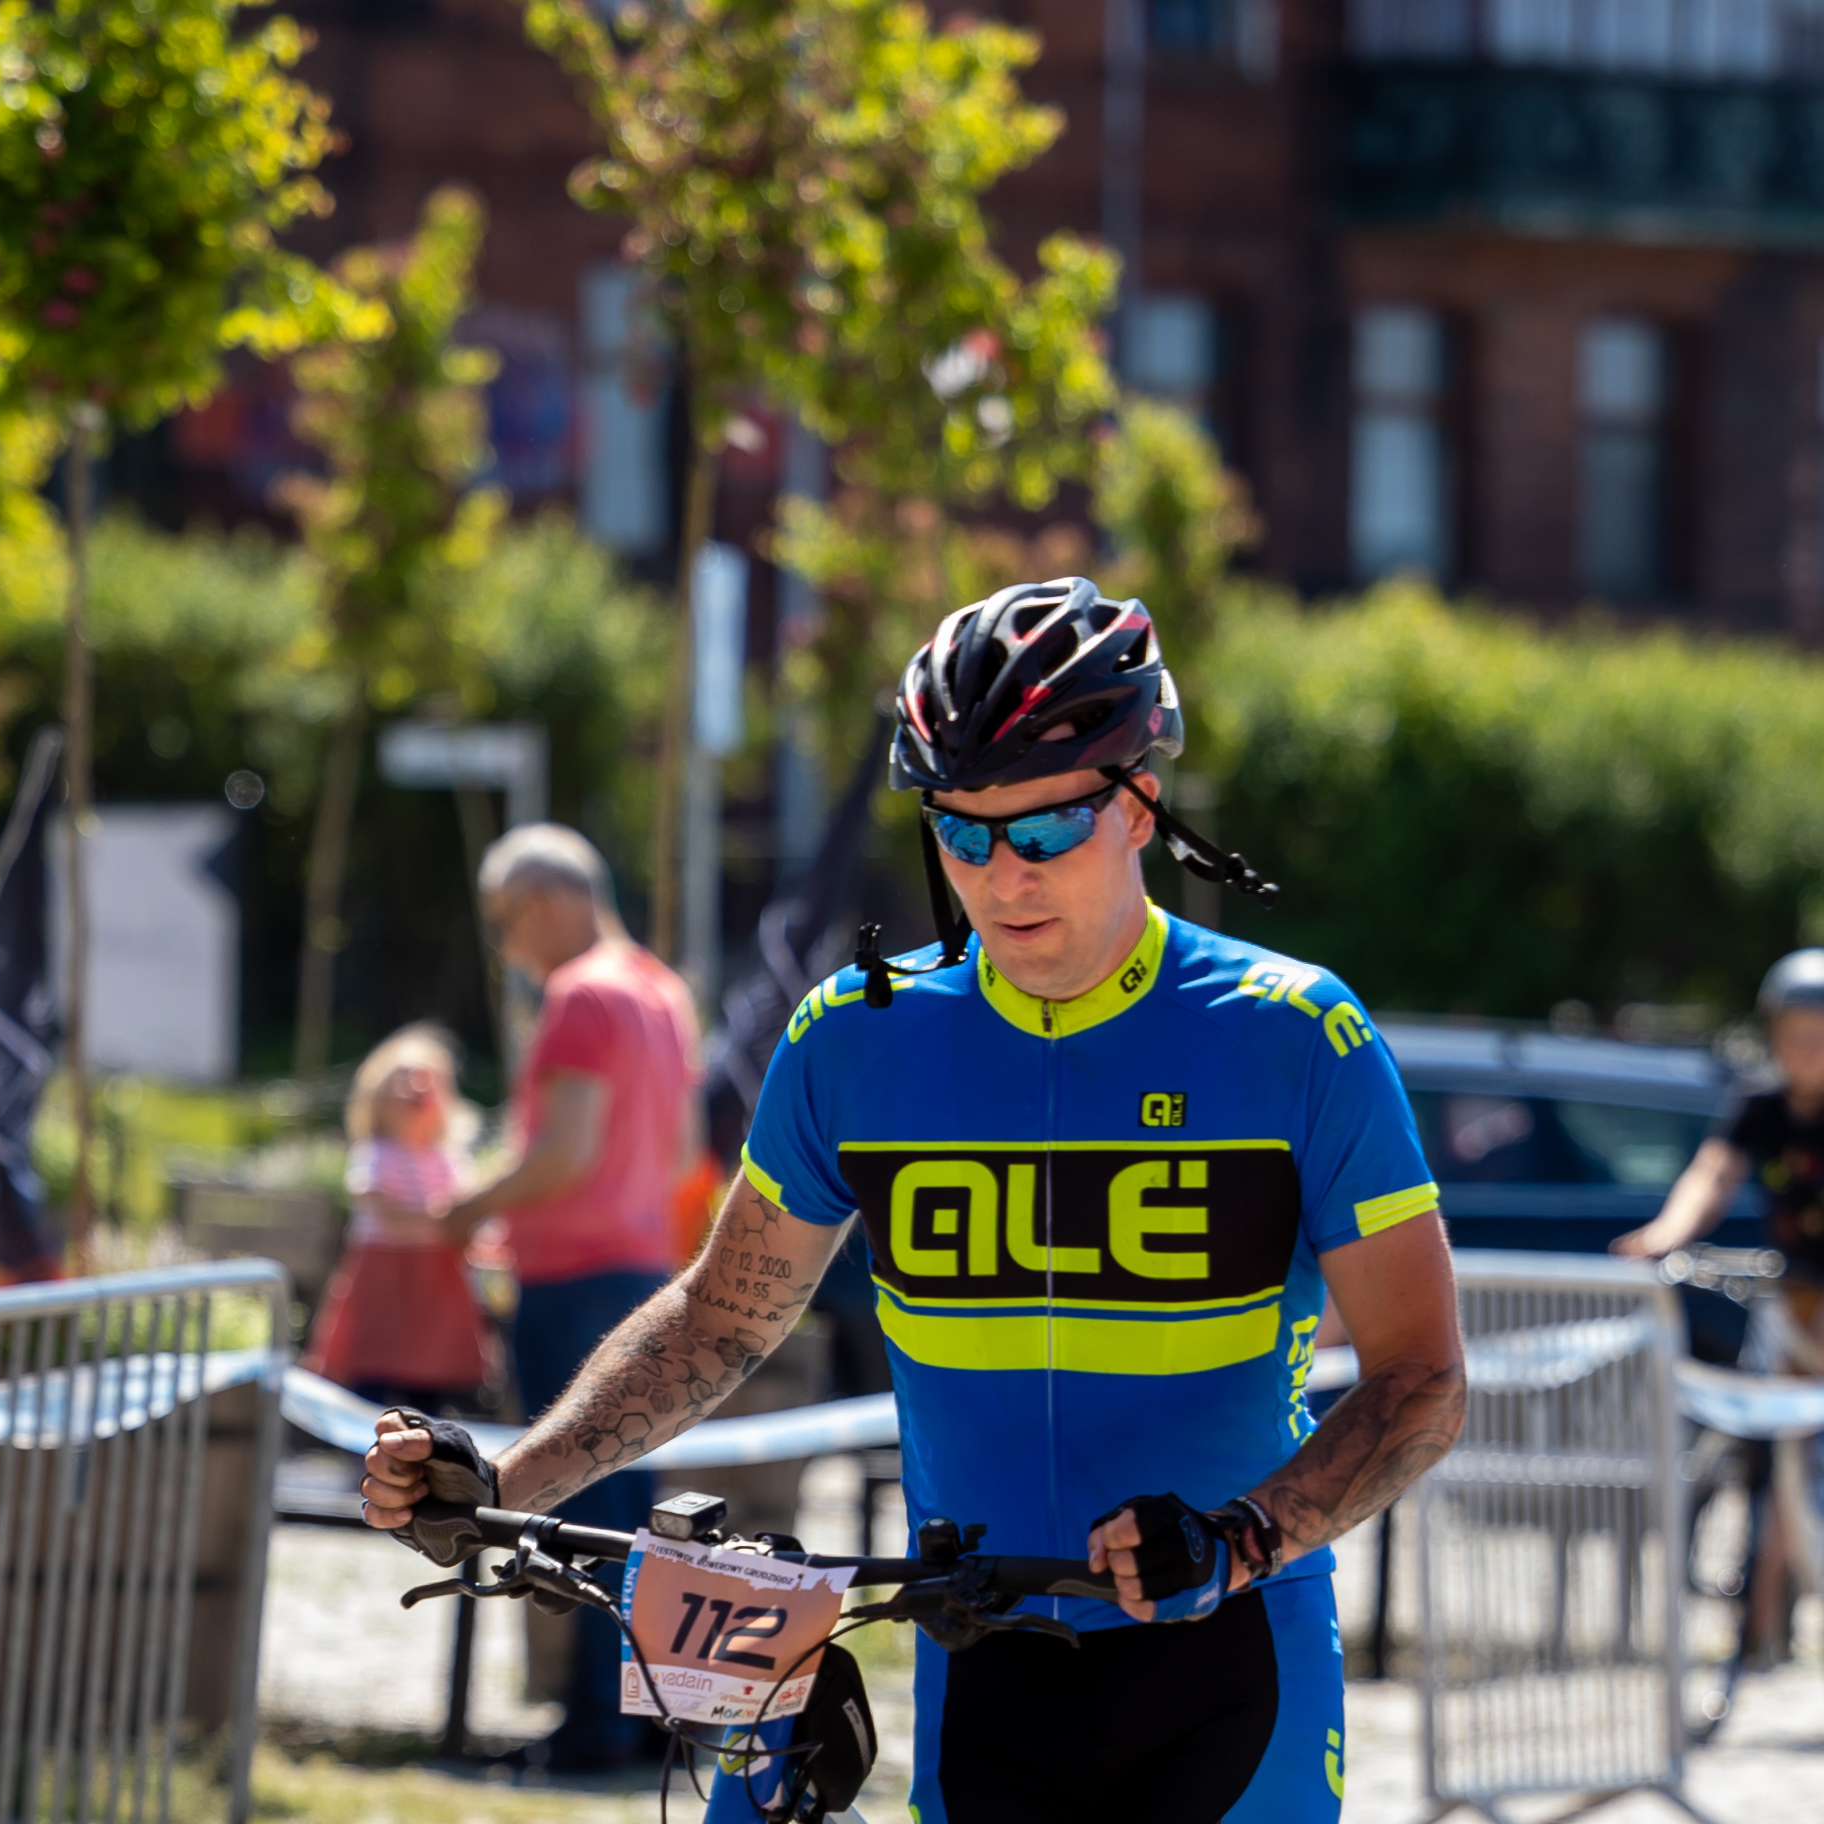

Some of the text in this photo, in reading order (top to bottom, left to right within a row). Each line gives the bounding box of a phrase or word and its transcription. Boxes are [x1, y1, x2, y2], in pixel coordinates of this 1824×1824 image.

[720, 1246, 792, 1279] 07.12.2020
[735, 1278, 770, 1299] 19:55
[670, 1592, 788, 1670] 112
